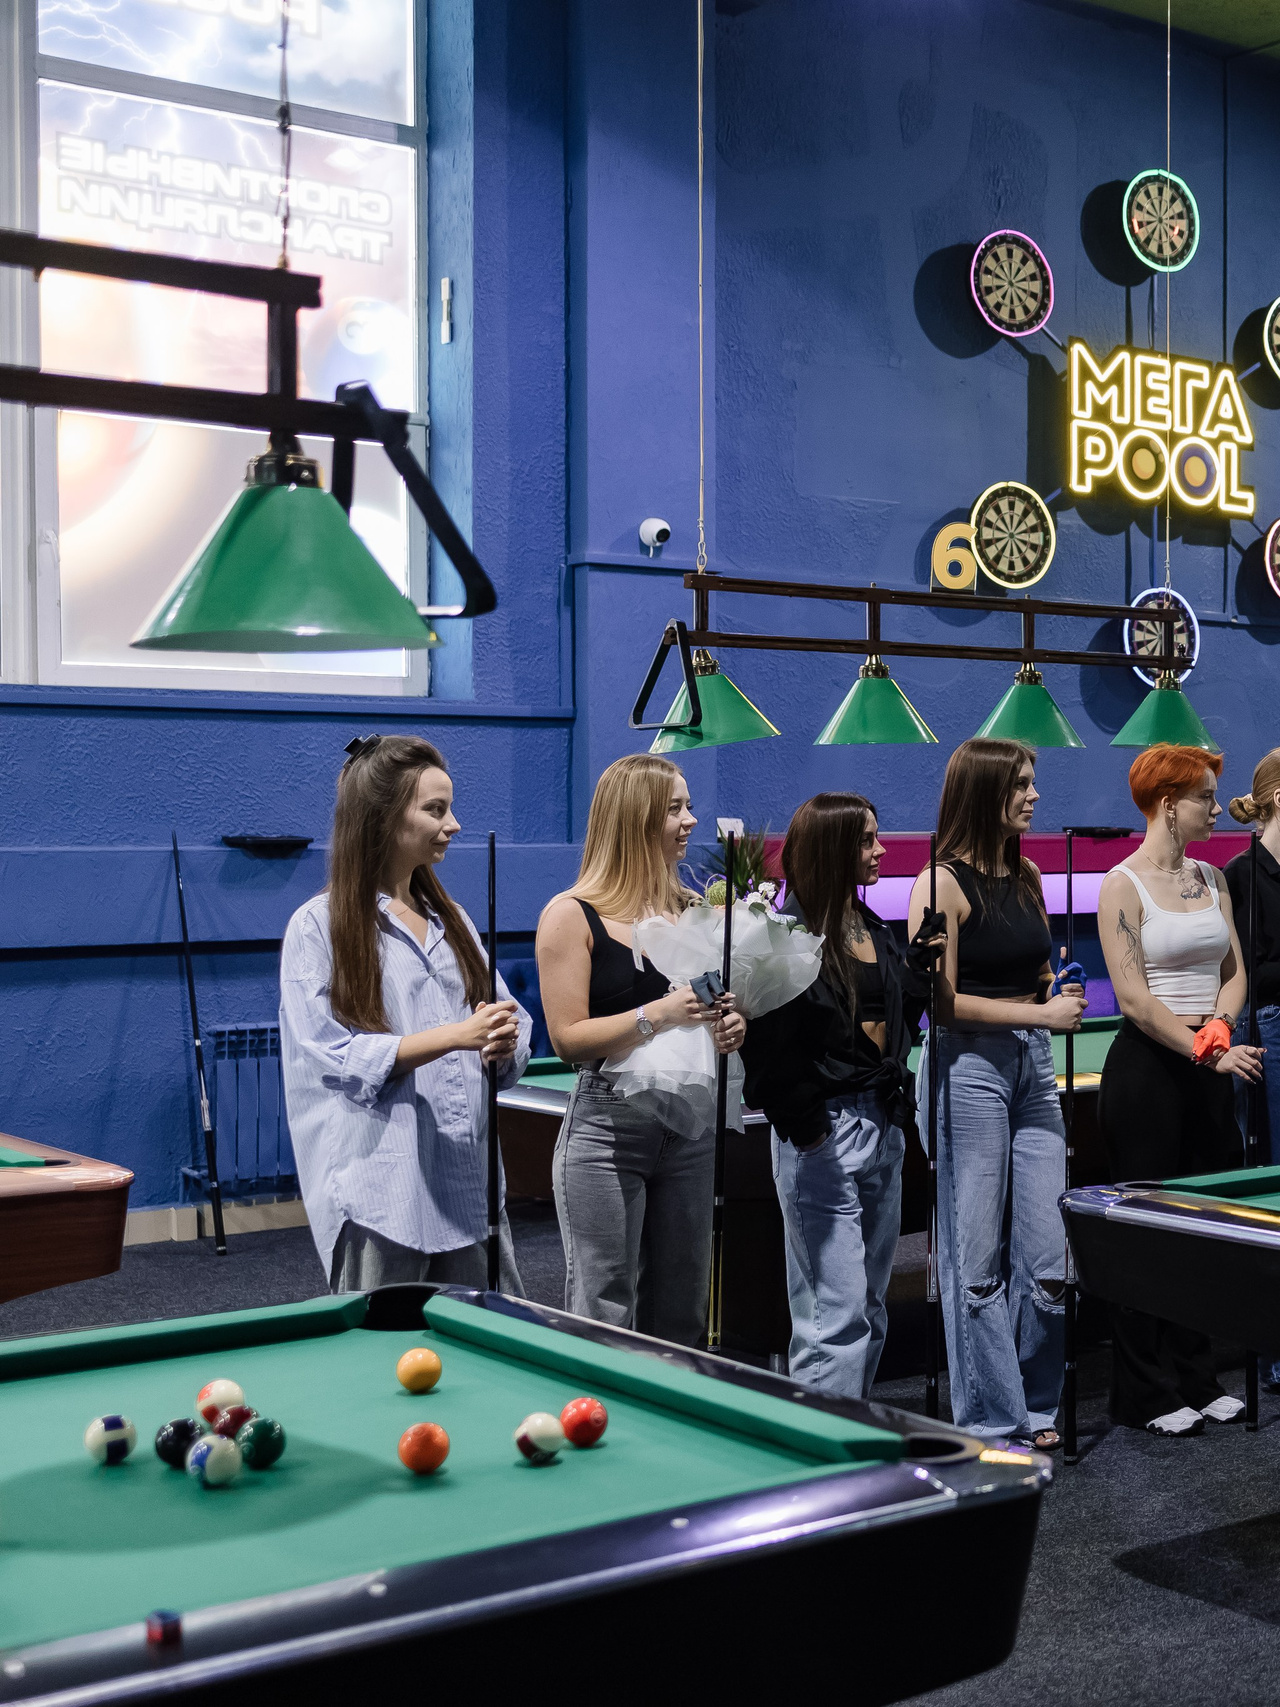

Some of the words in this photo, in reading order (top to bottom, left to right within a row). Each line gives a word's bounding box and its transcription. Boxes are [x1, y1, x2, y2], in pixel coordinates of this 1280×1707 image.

[1070, 341, 1253, 444] МЕГА
[1069, 418, 1255, 515] POOL
[933, 522, 978, 590] 6
